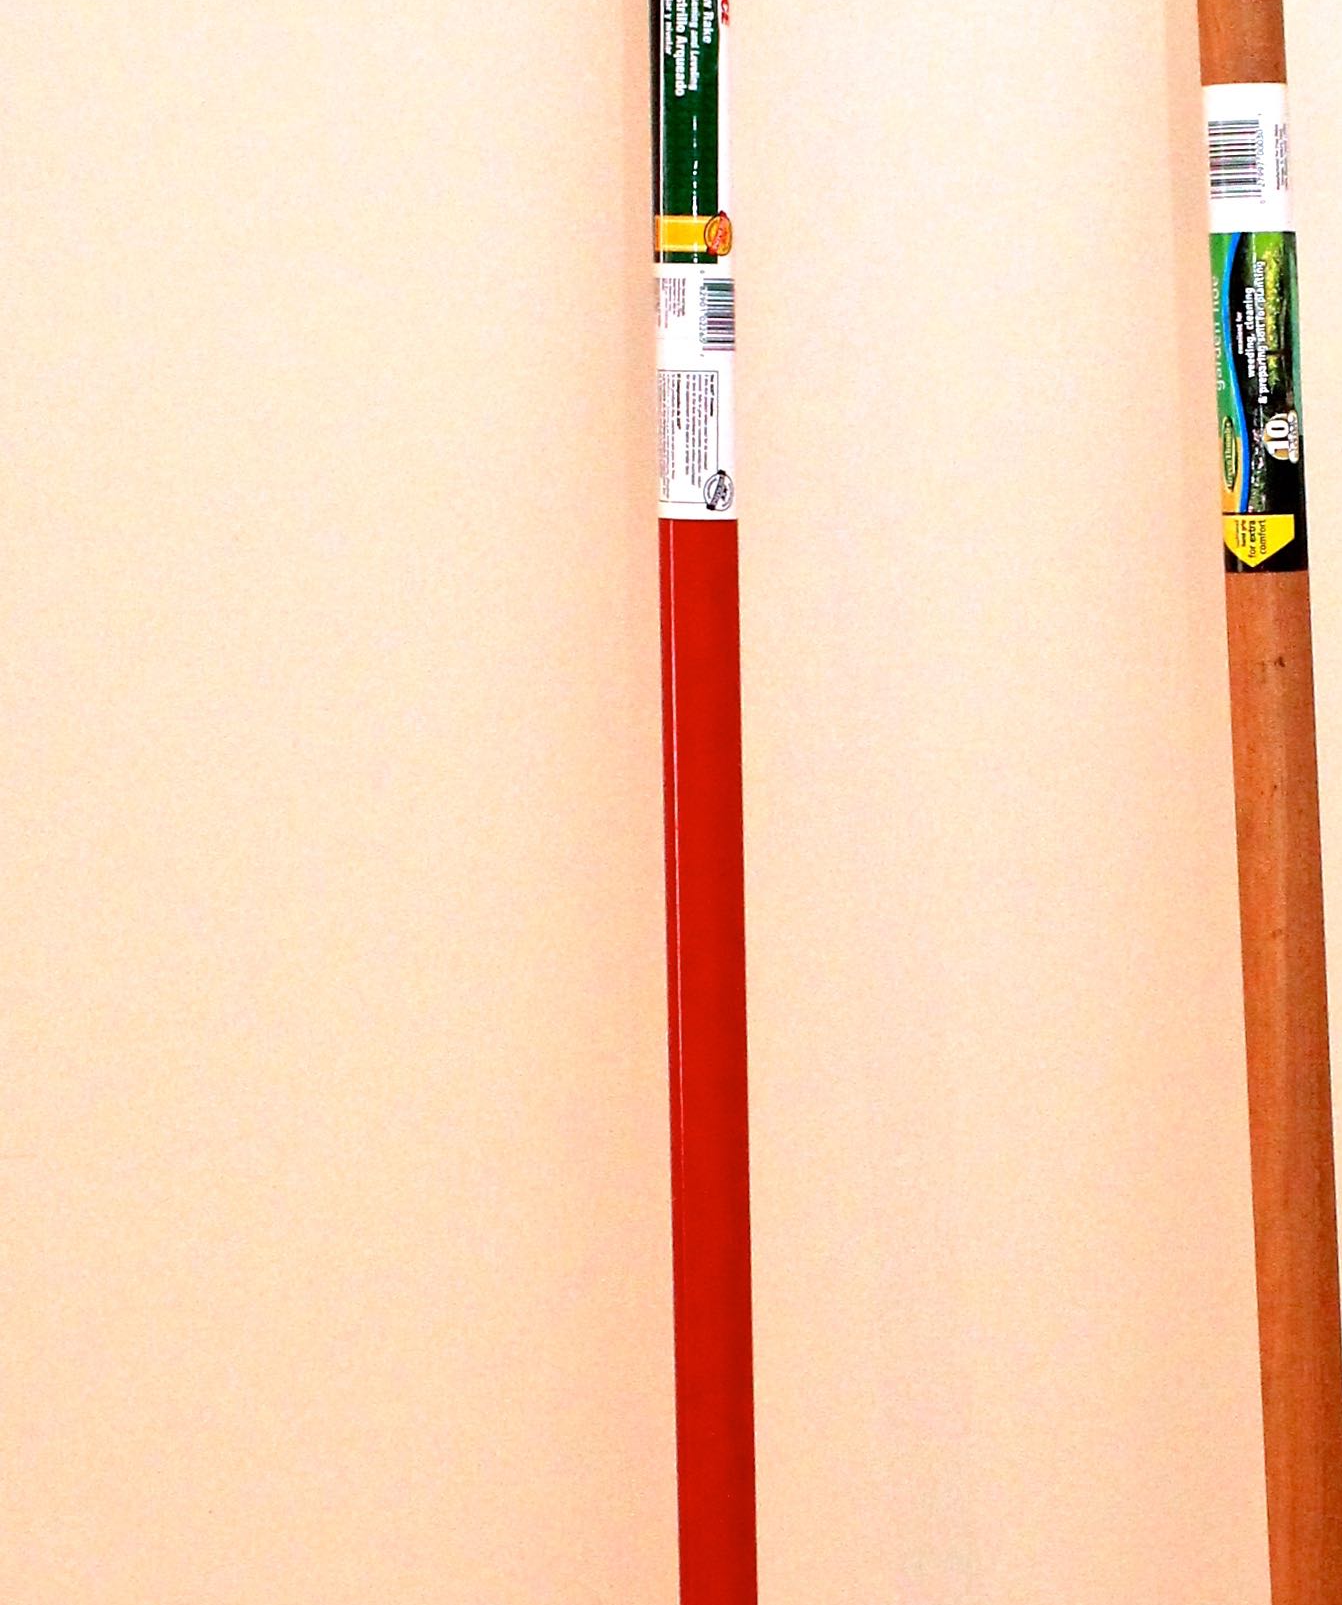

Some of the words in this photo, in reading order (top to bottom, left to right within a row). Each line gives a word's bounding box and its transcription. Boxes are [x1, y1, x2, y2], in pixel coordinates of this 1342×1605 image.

[690, 29, 700, 48] and
[702, 11, 714, 44] Rake
[673, 35, 688, 96] Arqueado
[1254, 261, 1266, 302] planting
[1243, 287, 1254, 330] cleaning
[1255, 306, 1265, 321] for
[1245, 333, 1256, 378] weeding,
[1256, 345, 1269, 394] preparing
[1266, 420, 1289, 454] 10
[1248, 520, 1256, 543] extra
[1258, 520, 1266, 554] comfort
[1248, 546, 1256, 558] for
